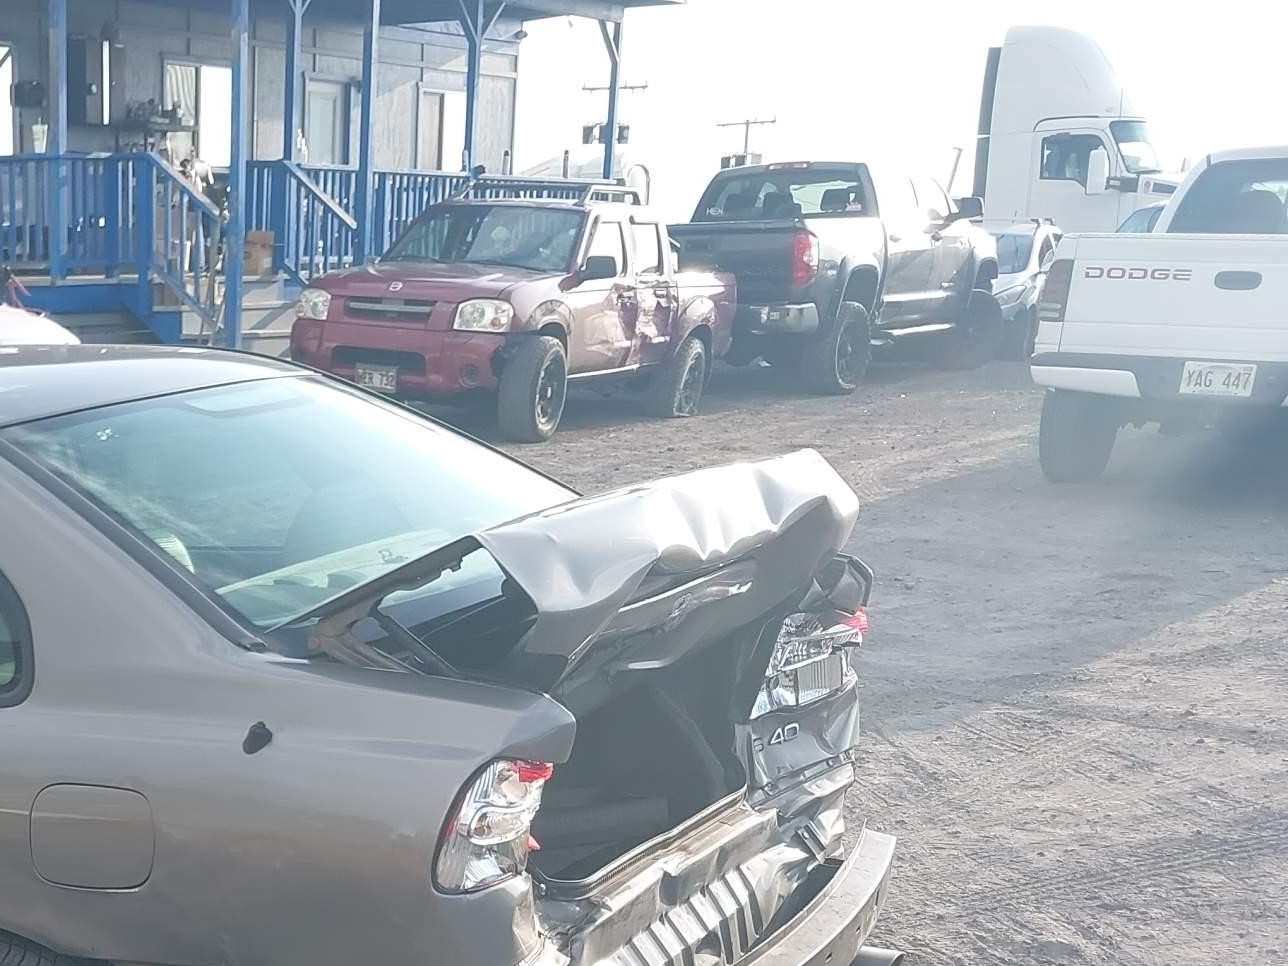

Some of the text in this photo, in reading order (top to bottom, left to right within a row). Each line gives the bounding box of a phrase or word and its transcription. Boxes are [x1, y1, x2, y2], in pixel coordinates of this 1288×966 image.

[1085, 267, 1193, 281] DODGE
[1186, 369, 1252, 390] YAG 447
[768, 722, 800, 745] 40
